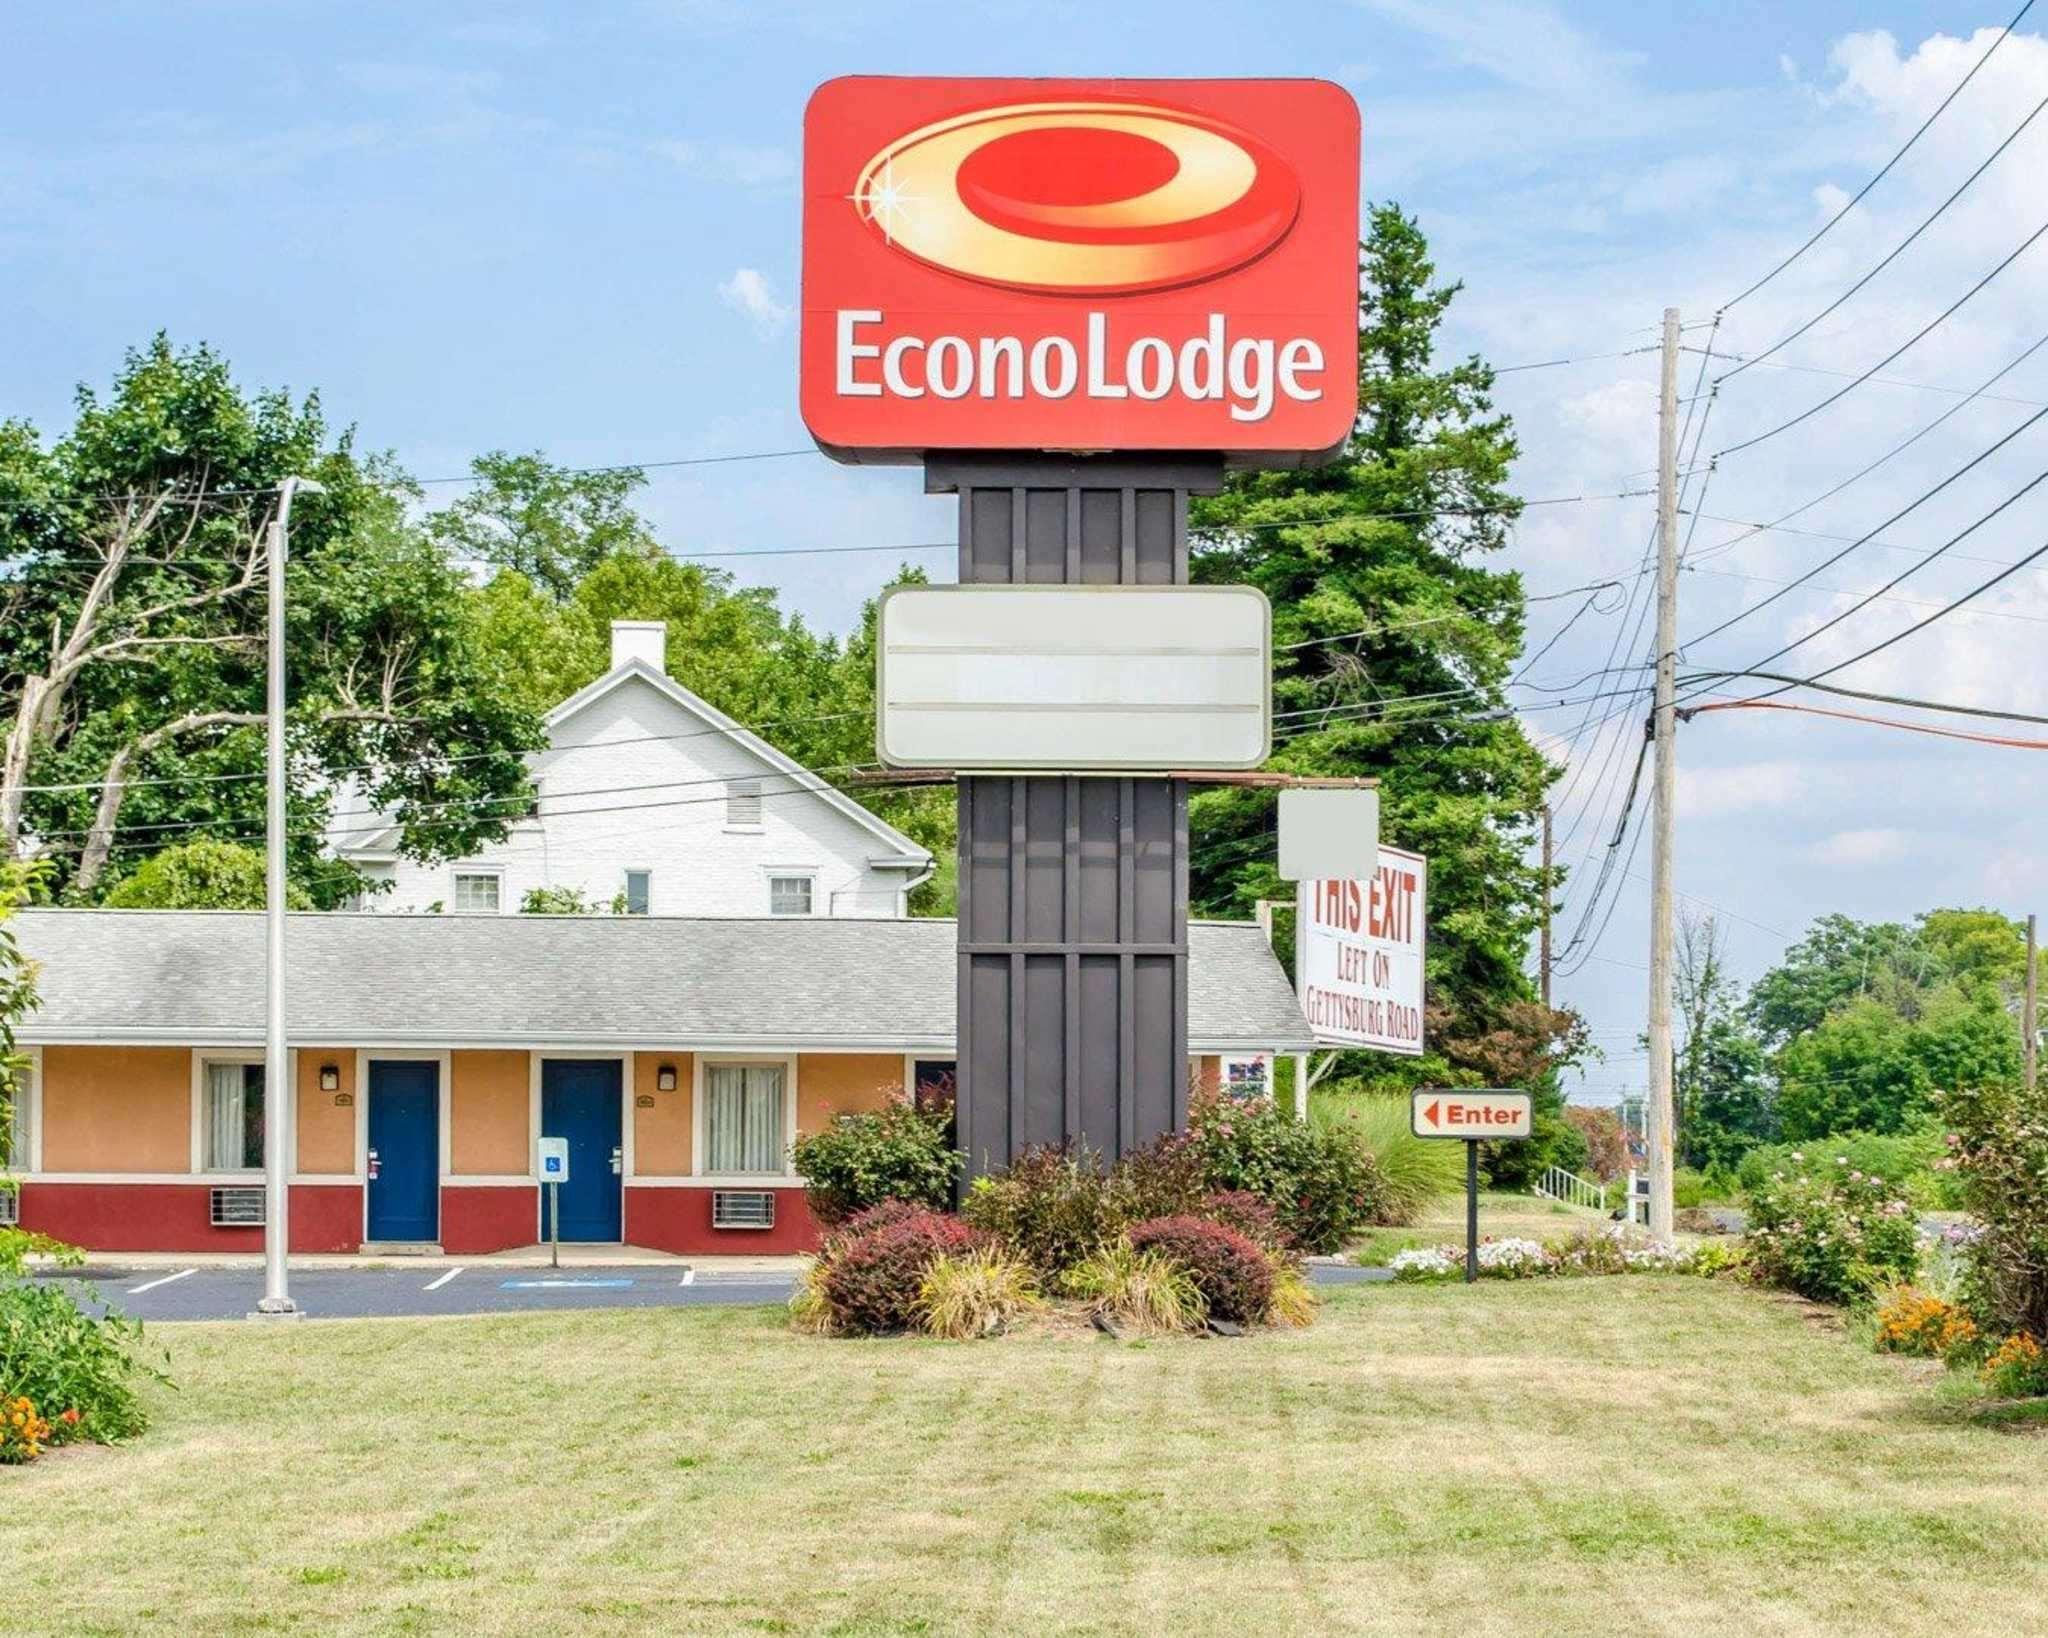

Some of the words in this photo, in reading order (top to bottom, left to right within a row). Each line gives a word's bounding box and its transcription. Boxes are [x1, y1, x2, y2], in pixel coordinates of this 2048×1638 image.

[1368, 865, 1416, 944] EXIT
[1337, 941, 1368, 985] LEFT
[1373, 949, 1391, 991] ON
[1306, 984, 1384, 1037] GETTYSBURG
[1386, 1000, 1420, 1042] ROAD
[1446, 1104, 1523, 1125] Enter
